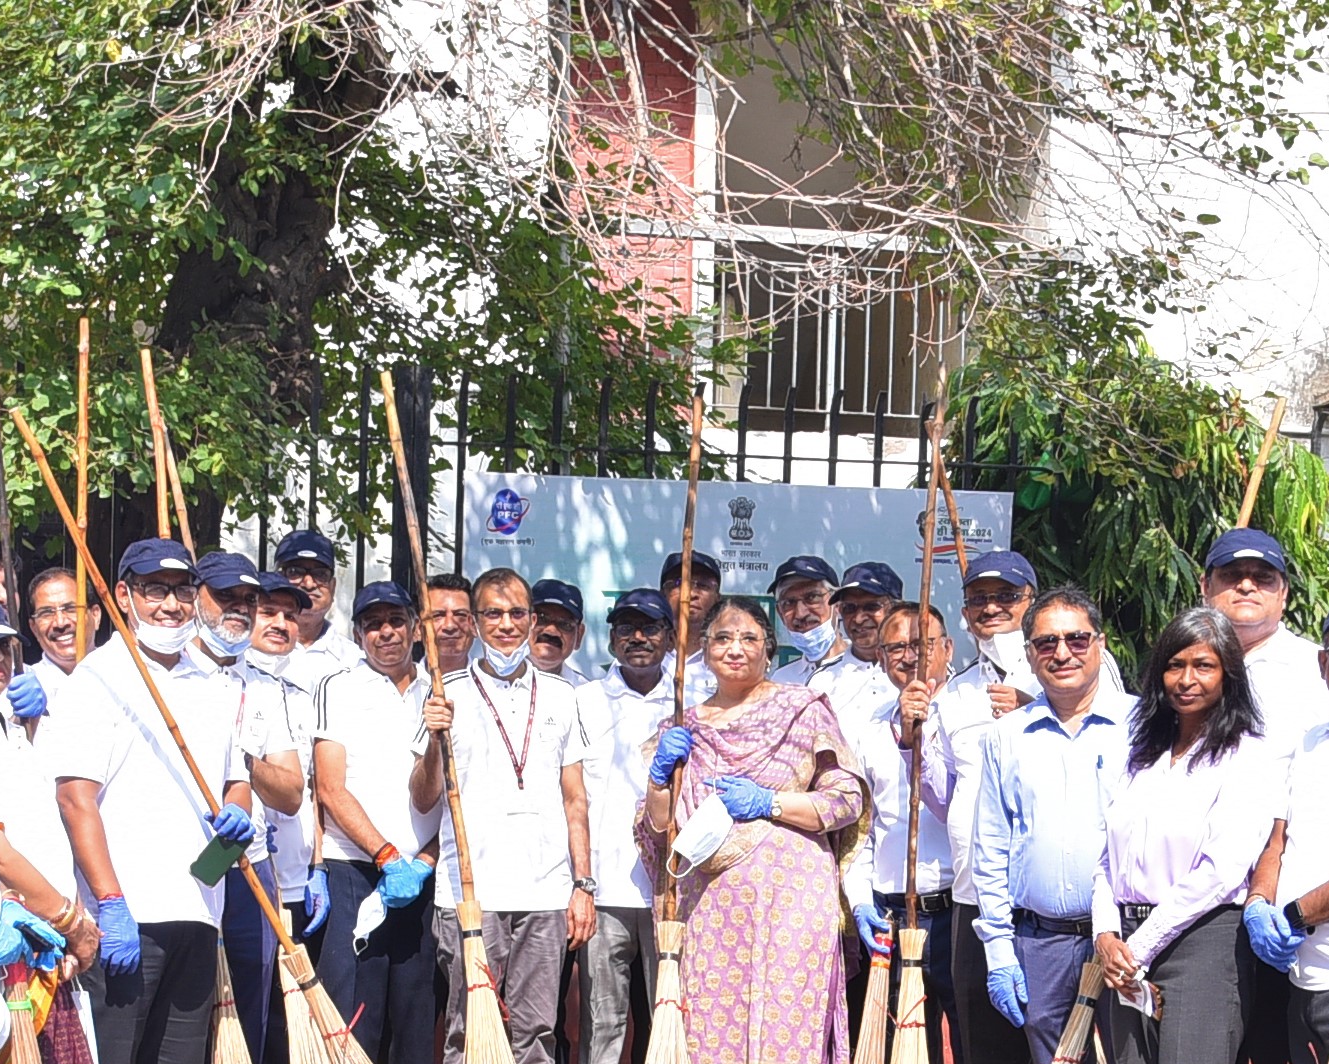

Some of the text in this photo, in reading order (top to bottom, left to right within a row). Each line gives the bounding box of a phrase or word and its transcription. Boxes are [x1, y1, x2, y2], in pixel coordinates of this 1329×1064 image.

[497, 511, 519, 519] PFC
[970, 528, 992, 537] 2024
[721, 549, 761, 558] भारत सरकार
[739, 560, 769, 571] मंत्रालय
